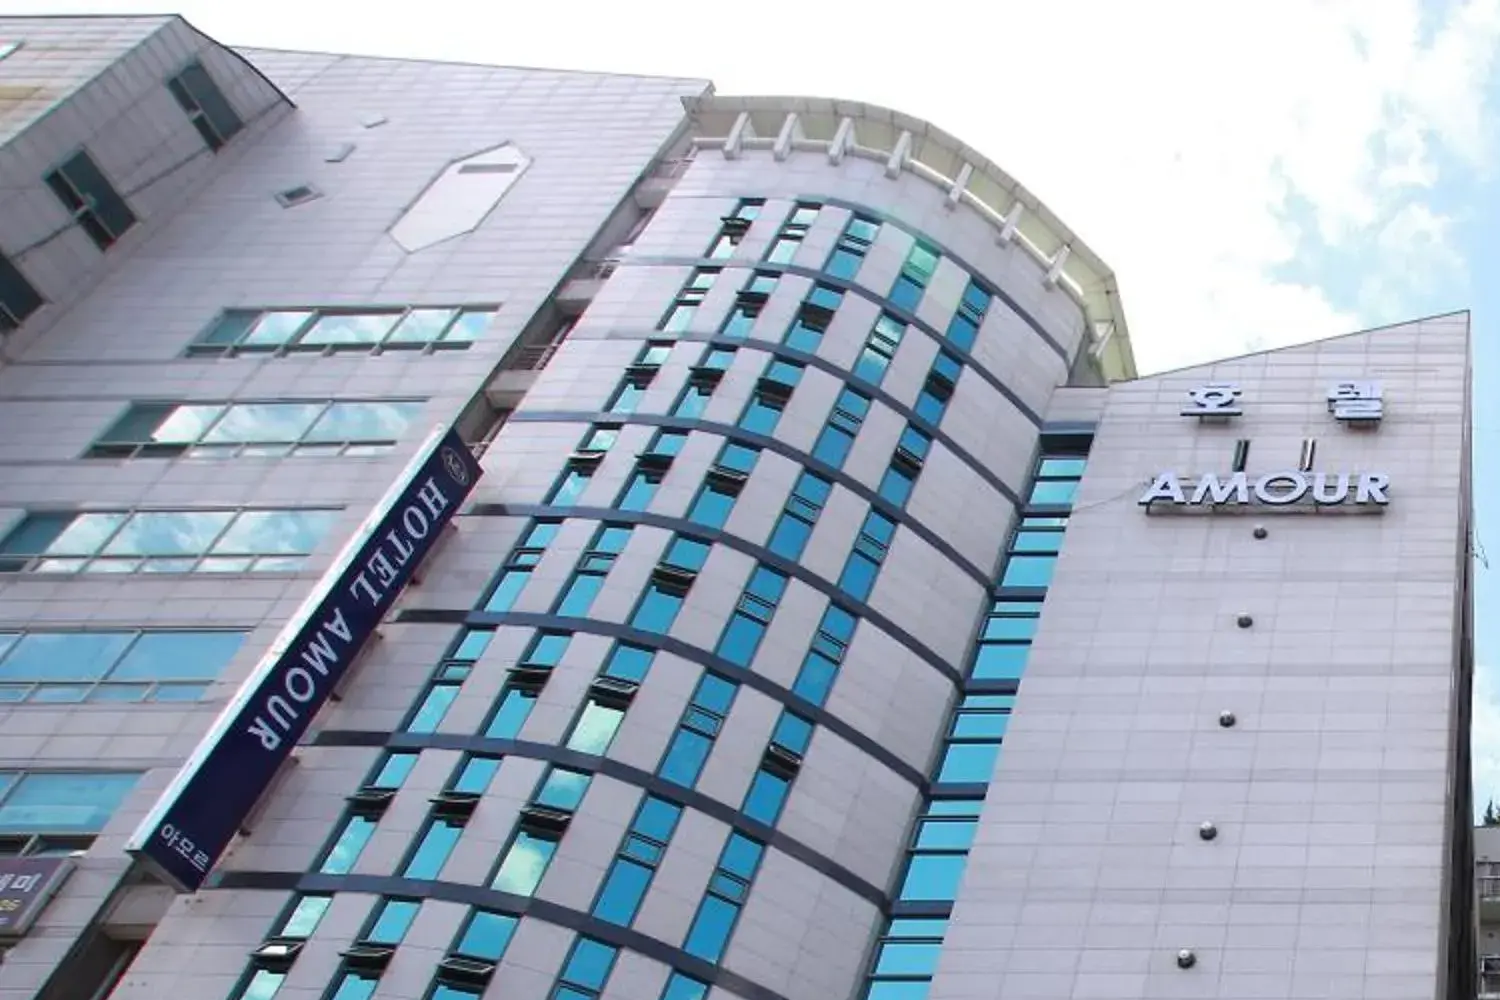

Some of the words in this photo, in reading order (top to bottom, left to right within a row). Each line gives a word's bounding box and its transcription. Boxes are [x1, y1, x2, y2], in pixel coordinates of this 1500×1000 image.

[1139, 470, 1390, 505] AMOUR
[349, 476, 449, 607] HOTEL
[247, 607, 354, 753] AMOUR
[160, 823, 208, 872] 아모르
